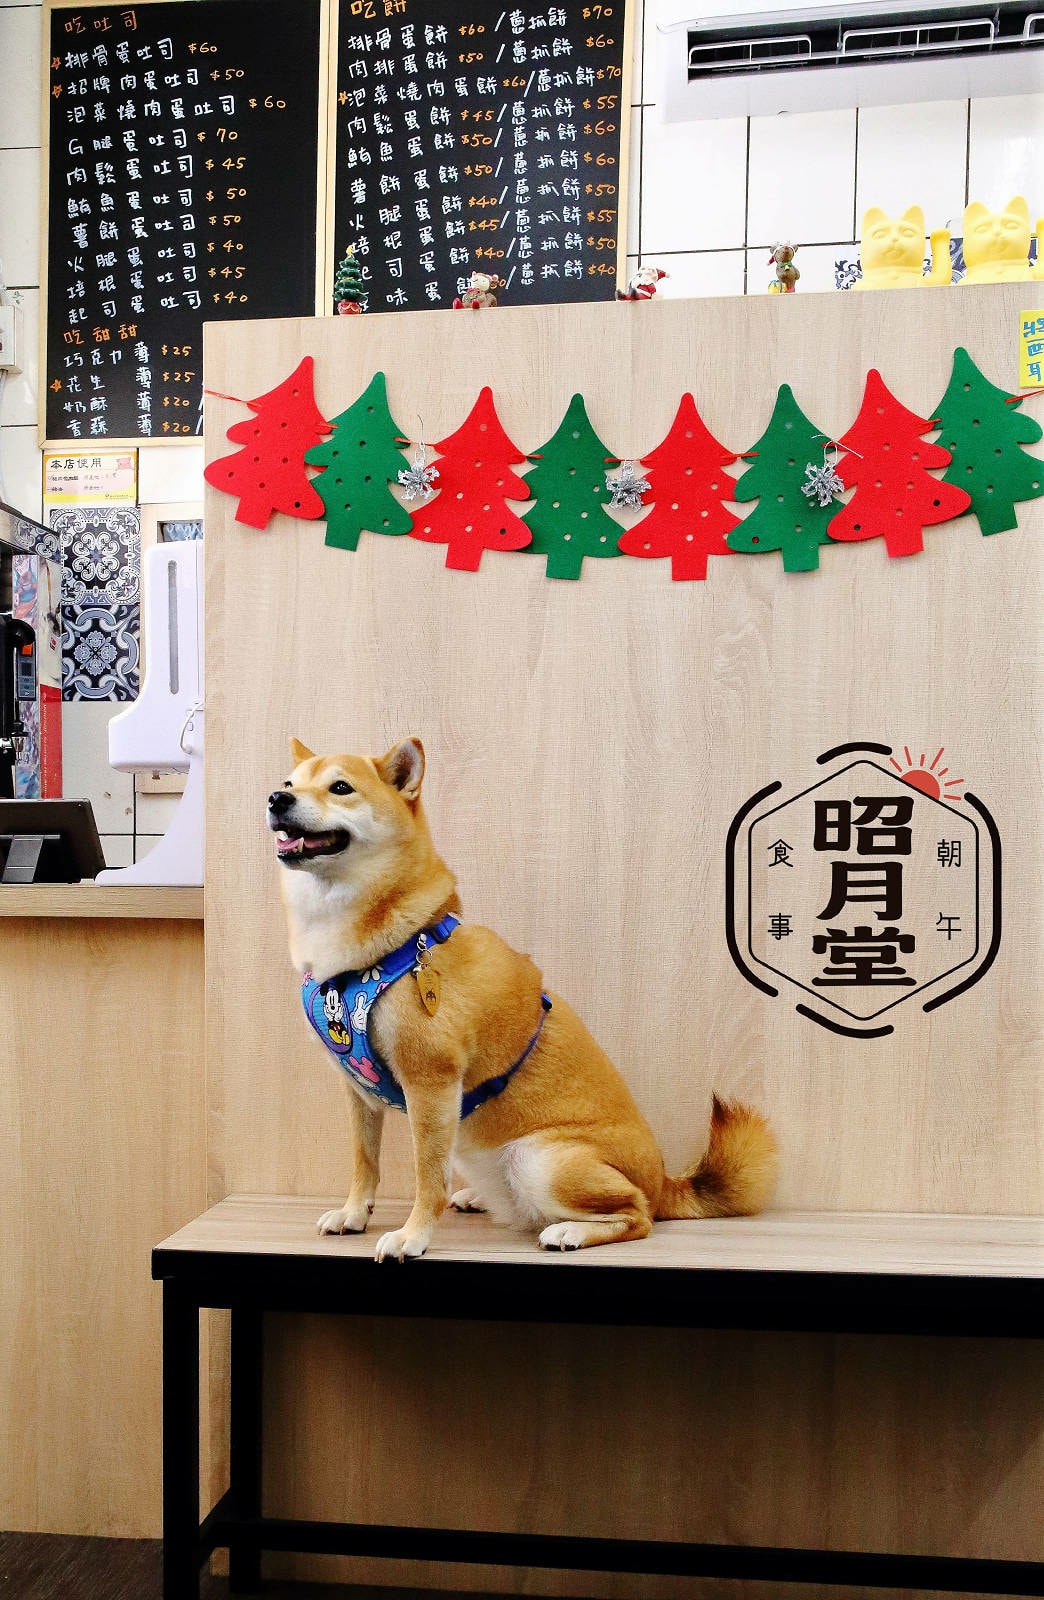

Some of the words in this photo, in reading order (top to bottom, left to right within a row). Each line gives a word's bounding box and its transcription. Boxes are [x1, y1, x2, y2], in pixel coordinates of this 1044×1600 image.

[64, 10, 138, 34] 吃吐司
[458, 24, 485, 36] $60
[582, 5, 613, 20] $70
[64, 37, 174, 69] 排骨蛋吐司
[188, 42, 218, 54] $60
[458, 52, 484, 64] $50
[586, 34, 615, 48] $60
[67, 68, 199, 95] 招牌肉蛋吐司
[210, 68, 245, 81] $50
[503, 75, 526, 87] $60
[596, 65, 622, 80] $70
[66, 94, 236, 124] 泡菜燒肉蛋吐司
[248, 96, 287, 109] $60
[460, 109, 495, 122] $45
[582, 95, 619, 110] $55
[197, 127, 238, 143] $70
[461, 133, 493, 148] $50
[583, 120, 616, 135] $60
[66, 154, 193, 186] 肉鬆蛋吐司
[205, 156, 247, 171] $45
[463, 164, 493, 177] $50
[583, 151, 616, 166] $60
[67, 188, 192, 219] 鮪魚蛋吐司
[205, 188, 247, 202] $50
[468, 195, 497, 209] $40
[584, 183, 616, 197] $50
[208, 214, 242, 226] $50
[468, 219, 500, 232] $45
[586, 209, 617, 222] $55
[67, 242, 196, 273] 火腿蛋吐司
[206, 239, 244, 253] $40
[475, 246, 505, 259] $40
[586, 236, 617, 251] $50
[66, 265, 197, 299] 培根蛋吐司
[207, 266, 246, 279] $45
[587, 263, 616, 276] $40
[68, 290, 201, 325] 起司蛋吐司
[212, 290, 249, 304] $40
[63, 323, 138, 345] 吃甜甜
[161, 344, 192, 357] $25
[162, 371, 195, 383] $25
[162, 396, 190, 407] $20
[161, 421, 191, 433] $20
[50, 457, 102, 470] 本店使用
[811, 795, 918, 988] 昭月堂
